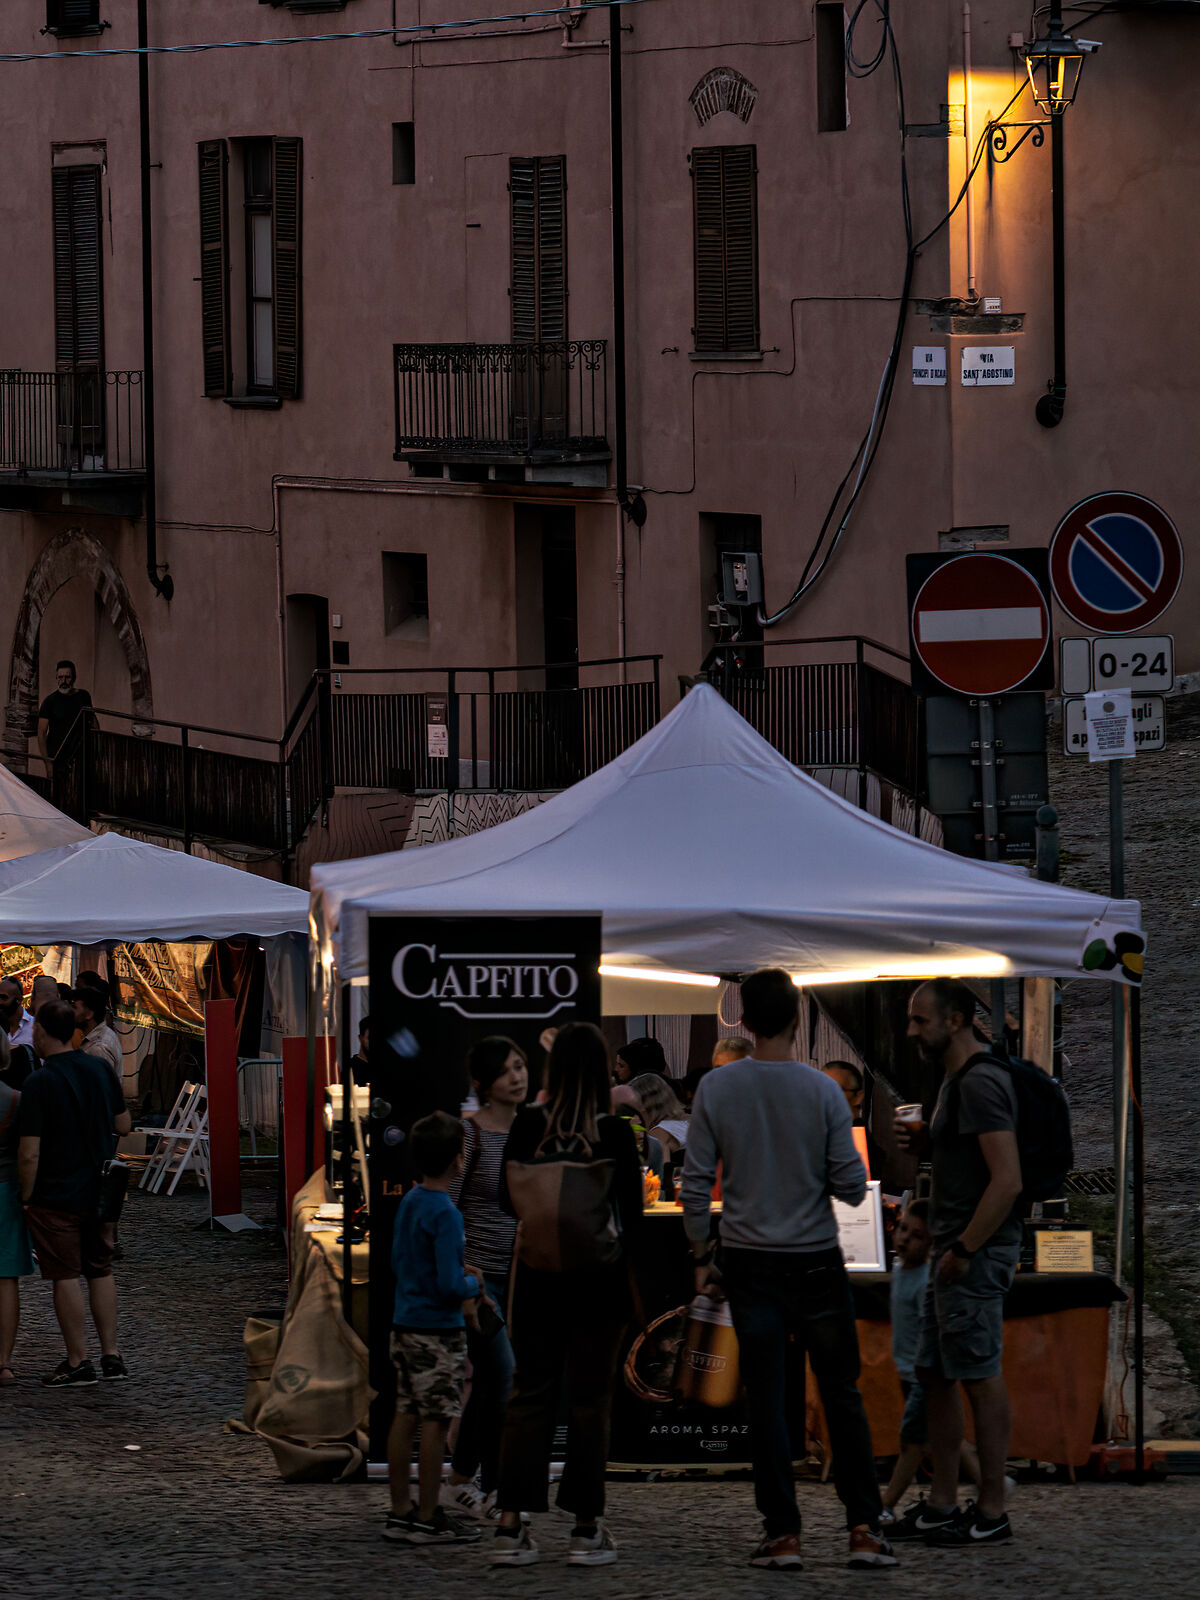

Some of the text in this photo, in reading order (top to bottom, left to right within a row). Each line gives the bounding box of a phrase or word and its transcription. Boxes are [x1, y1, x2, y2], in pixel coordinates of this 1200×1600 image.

[981, 353, 994, 363] VIA
[649, 1425, 749, 1434] AROMA SPAZ
